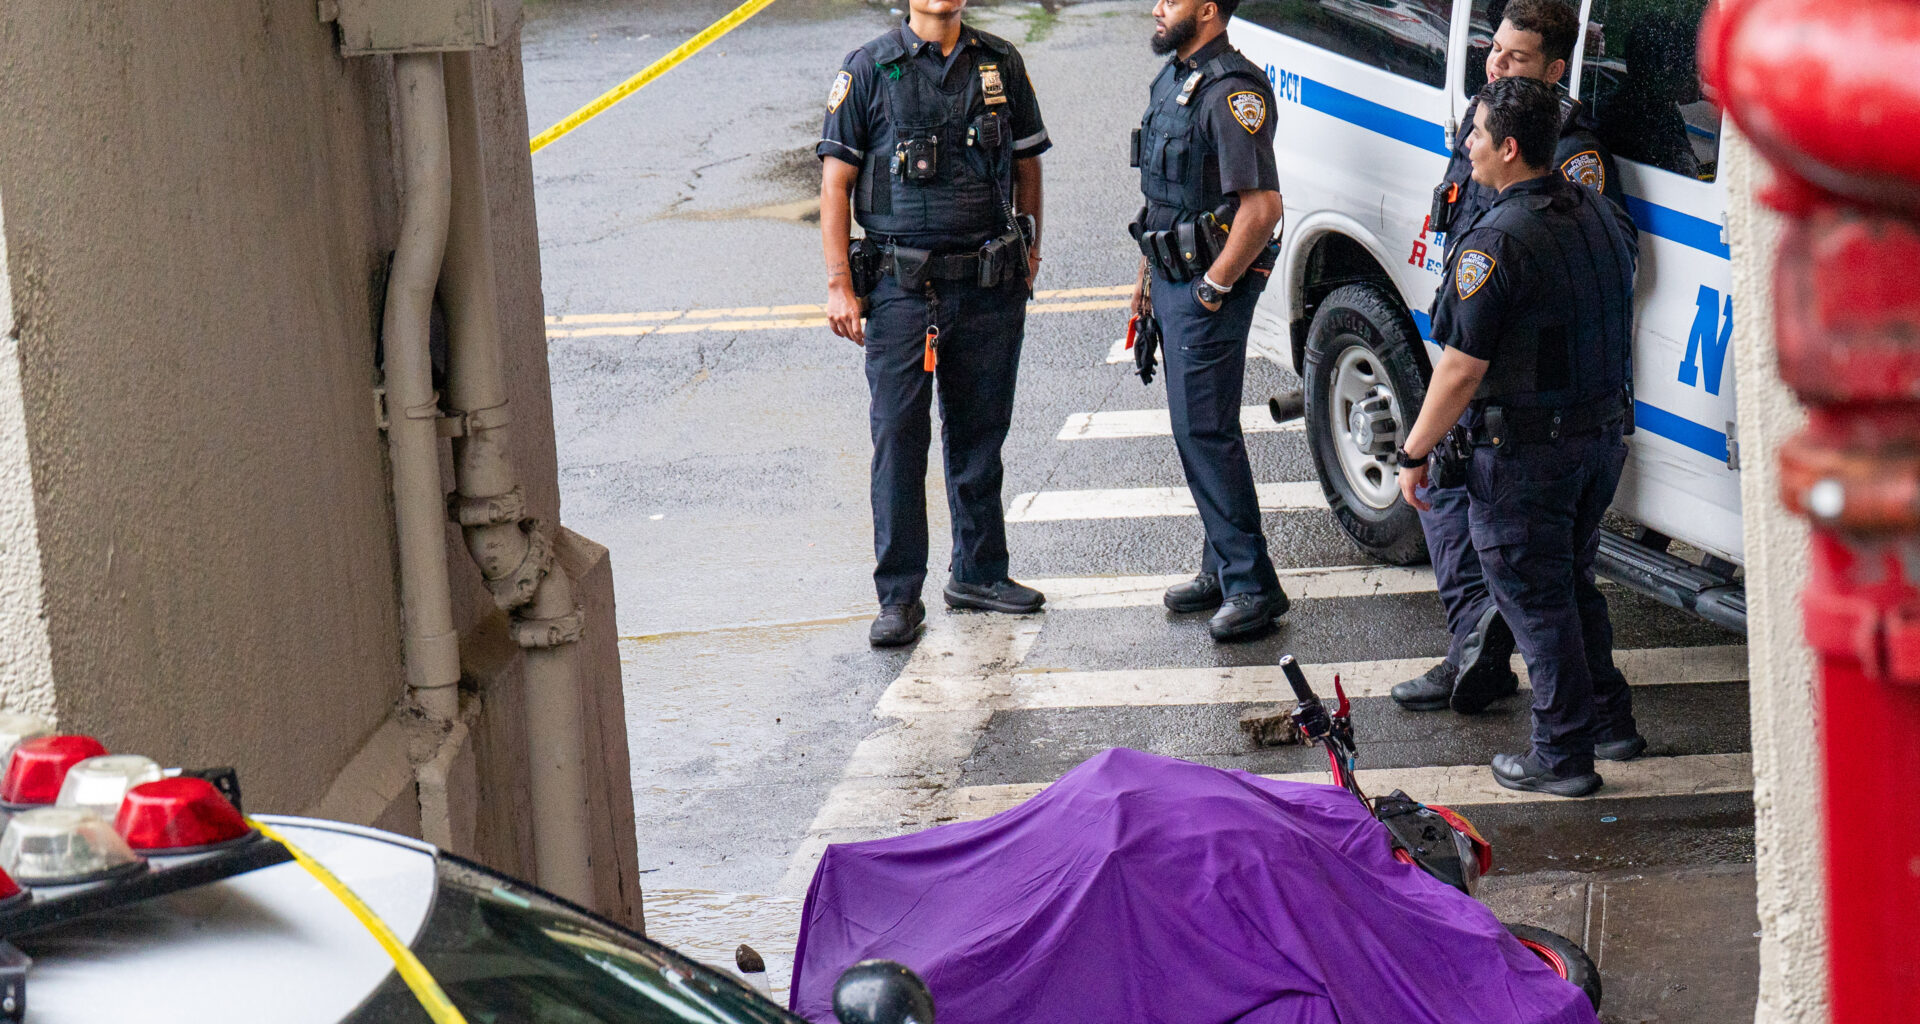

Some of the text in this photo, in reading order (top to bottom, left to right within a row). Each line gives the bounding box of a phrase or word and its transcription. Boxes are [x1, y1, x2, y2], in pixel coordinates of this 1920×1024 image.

[1280, 69, 1299, 103] PCT
[1570, 154, 1589, 166] POLICE
[1468, 253, 1486, 262] POLICE
